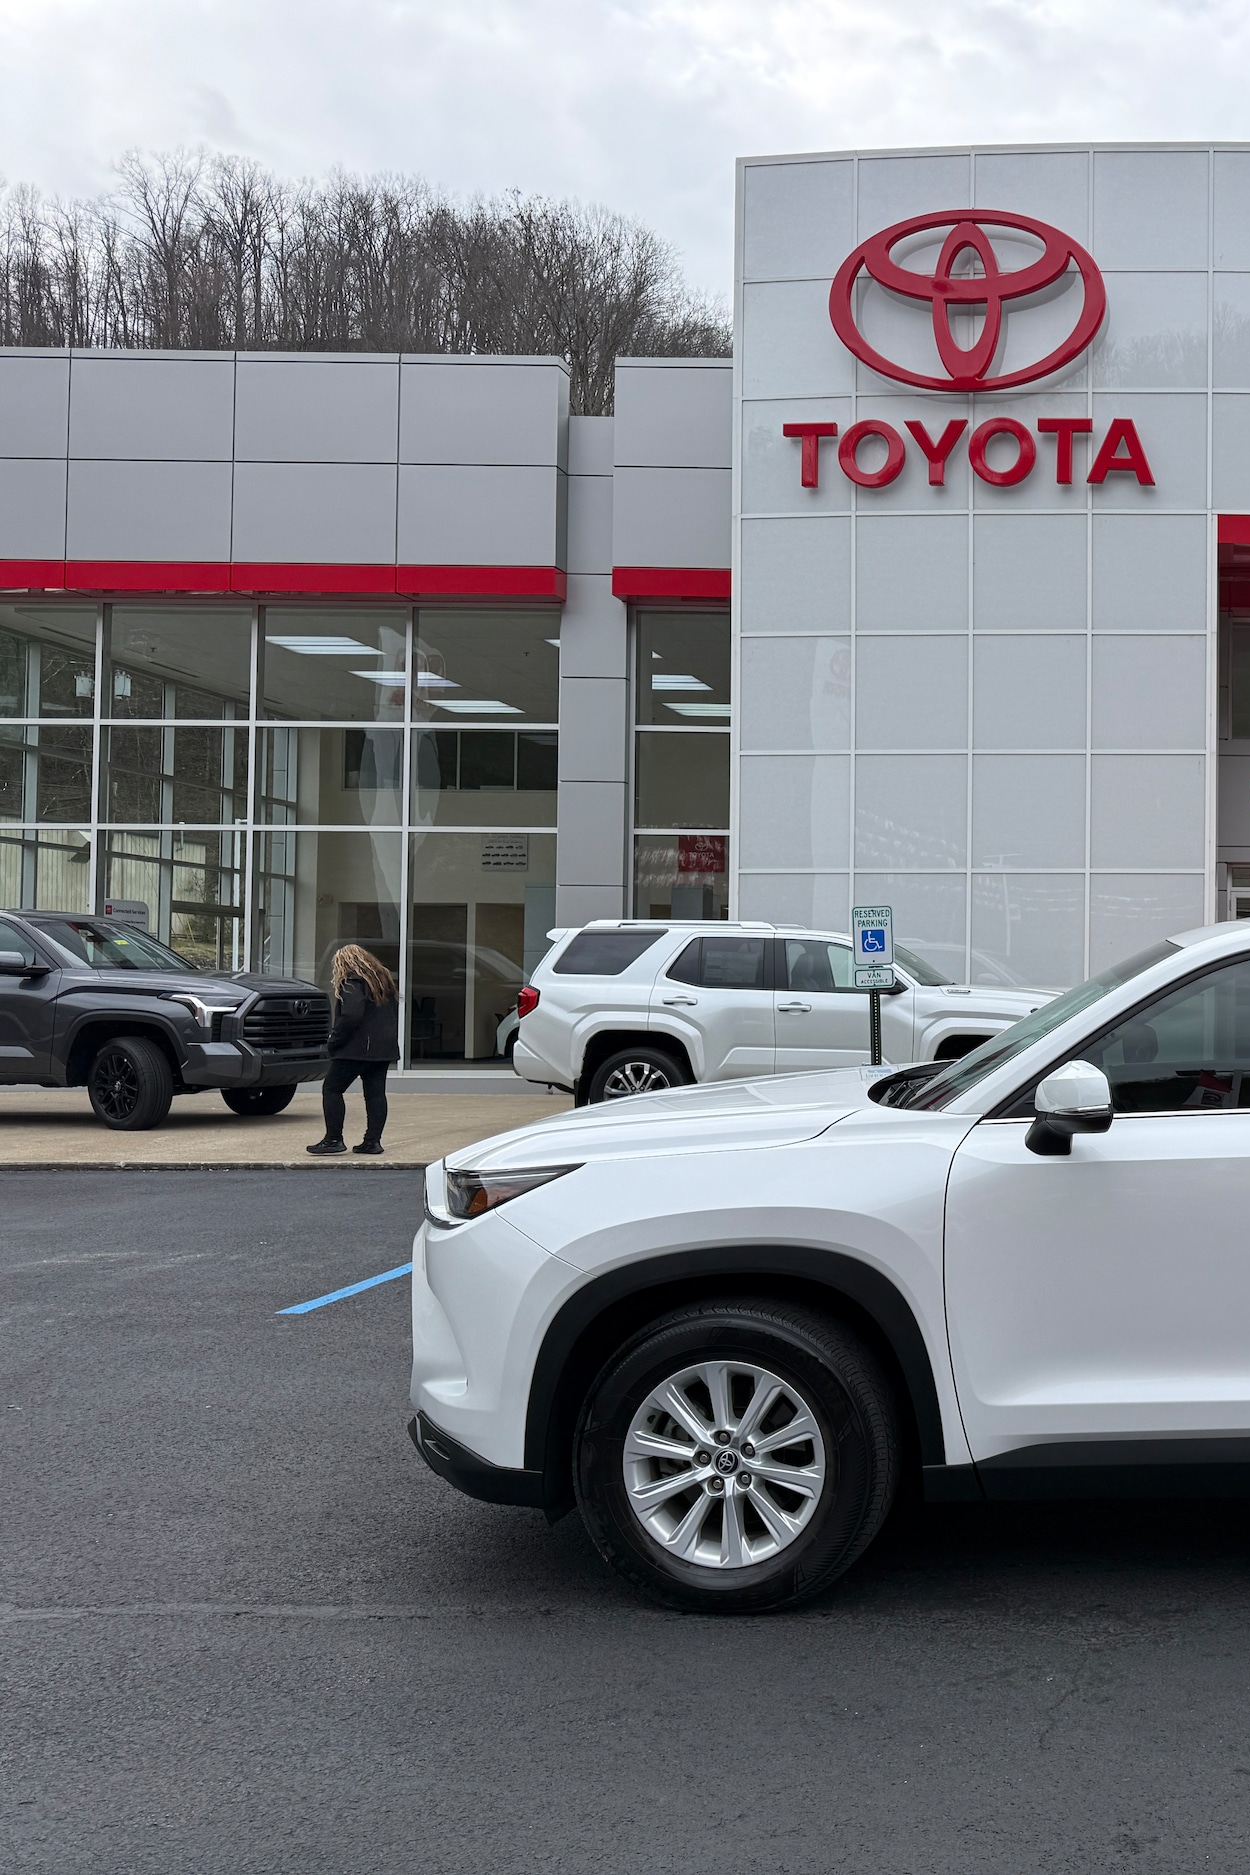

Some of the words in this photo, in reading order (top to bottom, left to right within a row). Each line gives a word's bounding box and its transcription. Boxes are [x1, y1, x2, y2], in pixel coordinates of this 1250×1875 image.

[782, 417, 1156, 489] TOYOTA
[855, 909, 890, 918] RESERVED
[857, 919, 888, 927] PARKING
